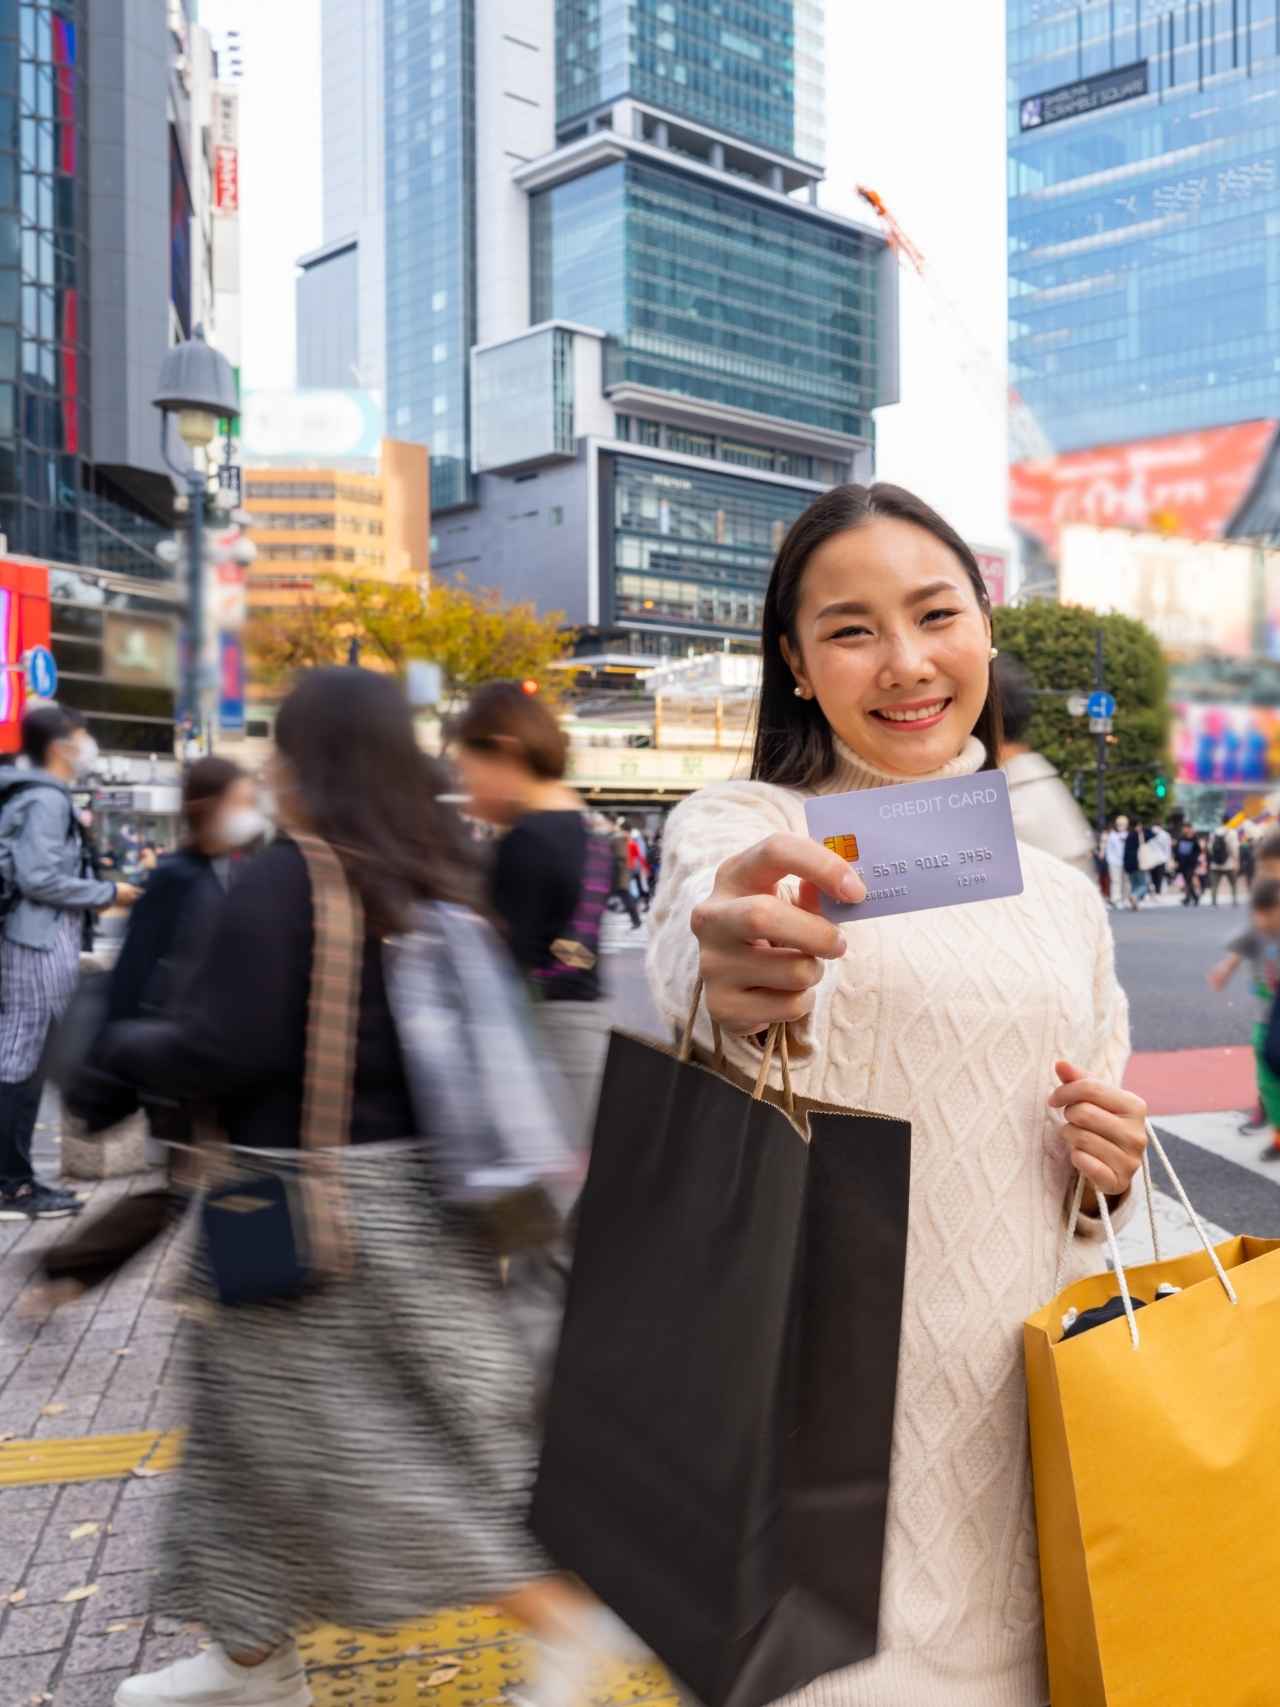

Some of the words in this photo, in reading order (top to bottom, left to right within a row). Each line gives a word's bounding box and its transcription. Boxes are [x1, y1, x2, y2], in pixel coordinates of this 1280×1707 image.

[879, 796, 943, 819] CREDIT
[948, 788, 998, 809] CARD
[872, 861, 907, 878] 5678
[914, 854, 950, 871] 9012
[958, 848, 992, 865] 3456
